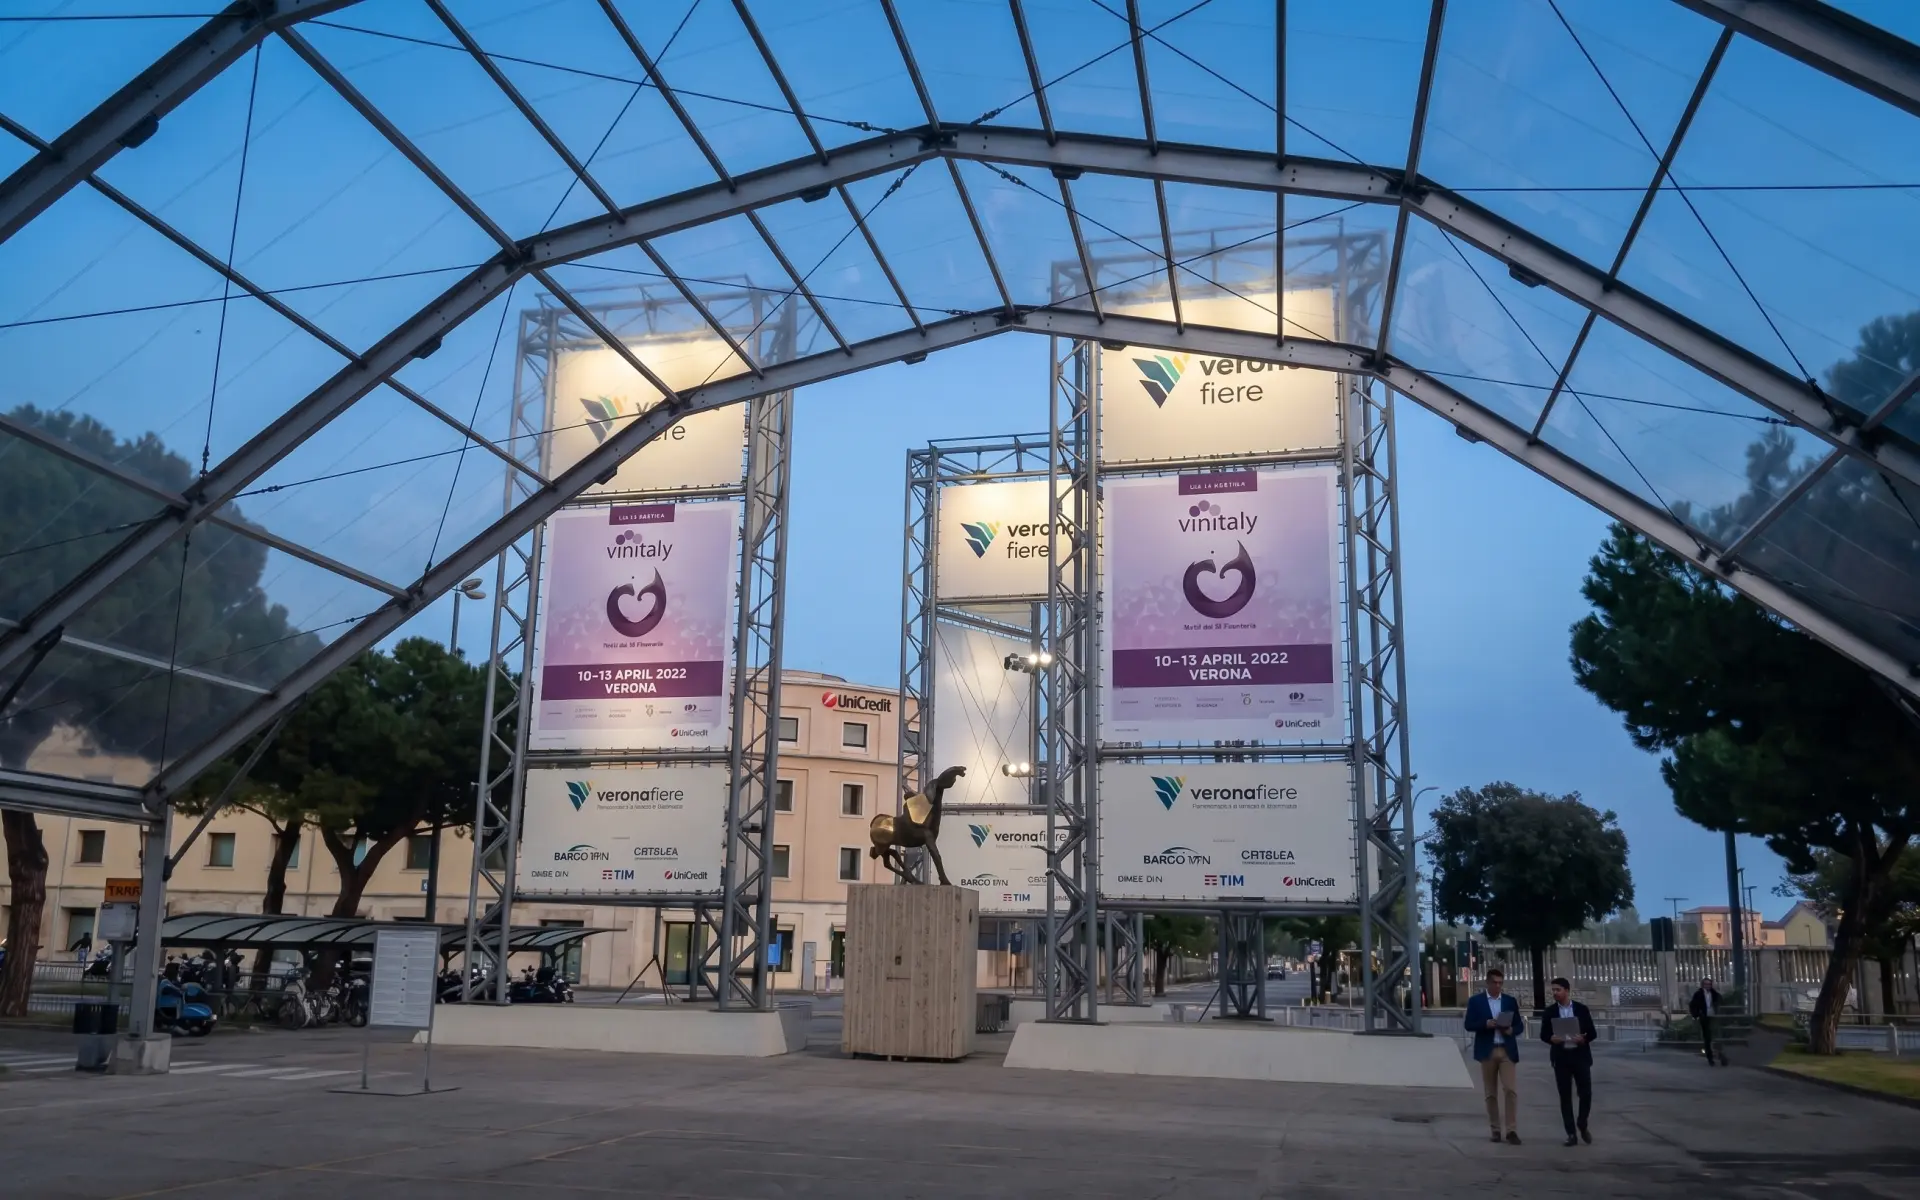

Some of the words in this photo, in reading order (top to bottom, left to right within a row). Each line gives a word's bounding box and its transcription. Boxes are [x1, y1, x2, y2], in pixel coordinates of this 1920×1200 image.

[1199, 358, 1300, 376] vero
[1199, 382, 1263, 405] fiere
[1178, 511, 1258, 535] vinitaly
[606, 539, 673, 562] vinitaly
[1007, 541, 1049, 558] fiere
[1201, 653, 1246, 666] APRIL
[1251, 652, 1288, 665] 2022
[615, 668, 653, 681] APRIL
[656, 667, 687, 680] 2022
[1189, 668, 1252, 681] VERONA
[605, 682, 657, 694] VERONA
[838, 694, 892, 713] UniCredit
[1284, 719, 1321, 729] UniCredit
[678, 729, 709, 737] UniCredit
[596, 786, 684, 802] veronafiere
[1190, 784, 1298, 800] veronafiere
[994, 830, 1067, 842] veronafire
[553, 852, 589, 861] BARCO
[1143, 855, 1186, 865] BARCO
[614, 869, 635, 880] TIM
[674, 871, 708, 880] UniCredit
[1219, 875, 1245, 886] TIM
[960, 878, 991, 886] BARCO
[1294, 876, 1336, 887] UniCredit
[1013, 893, 1031, 902] TIM
